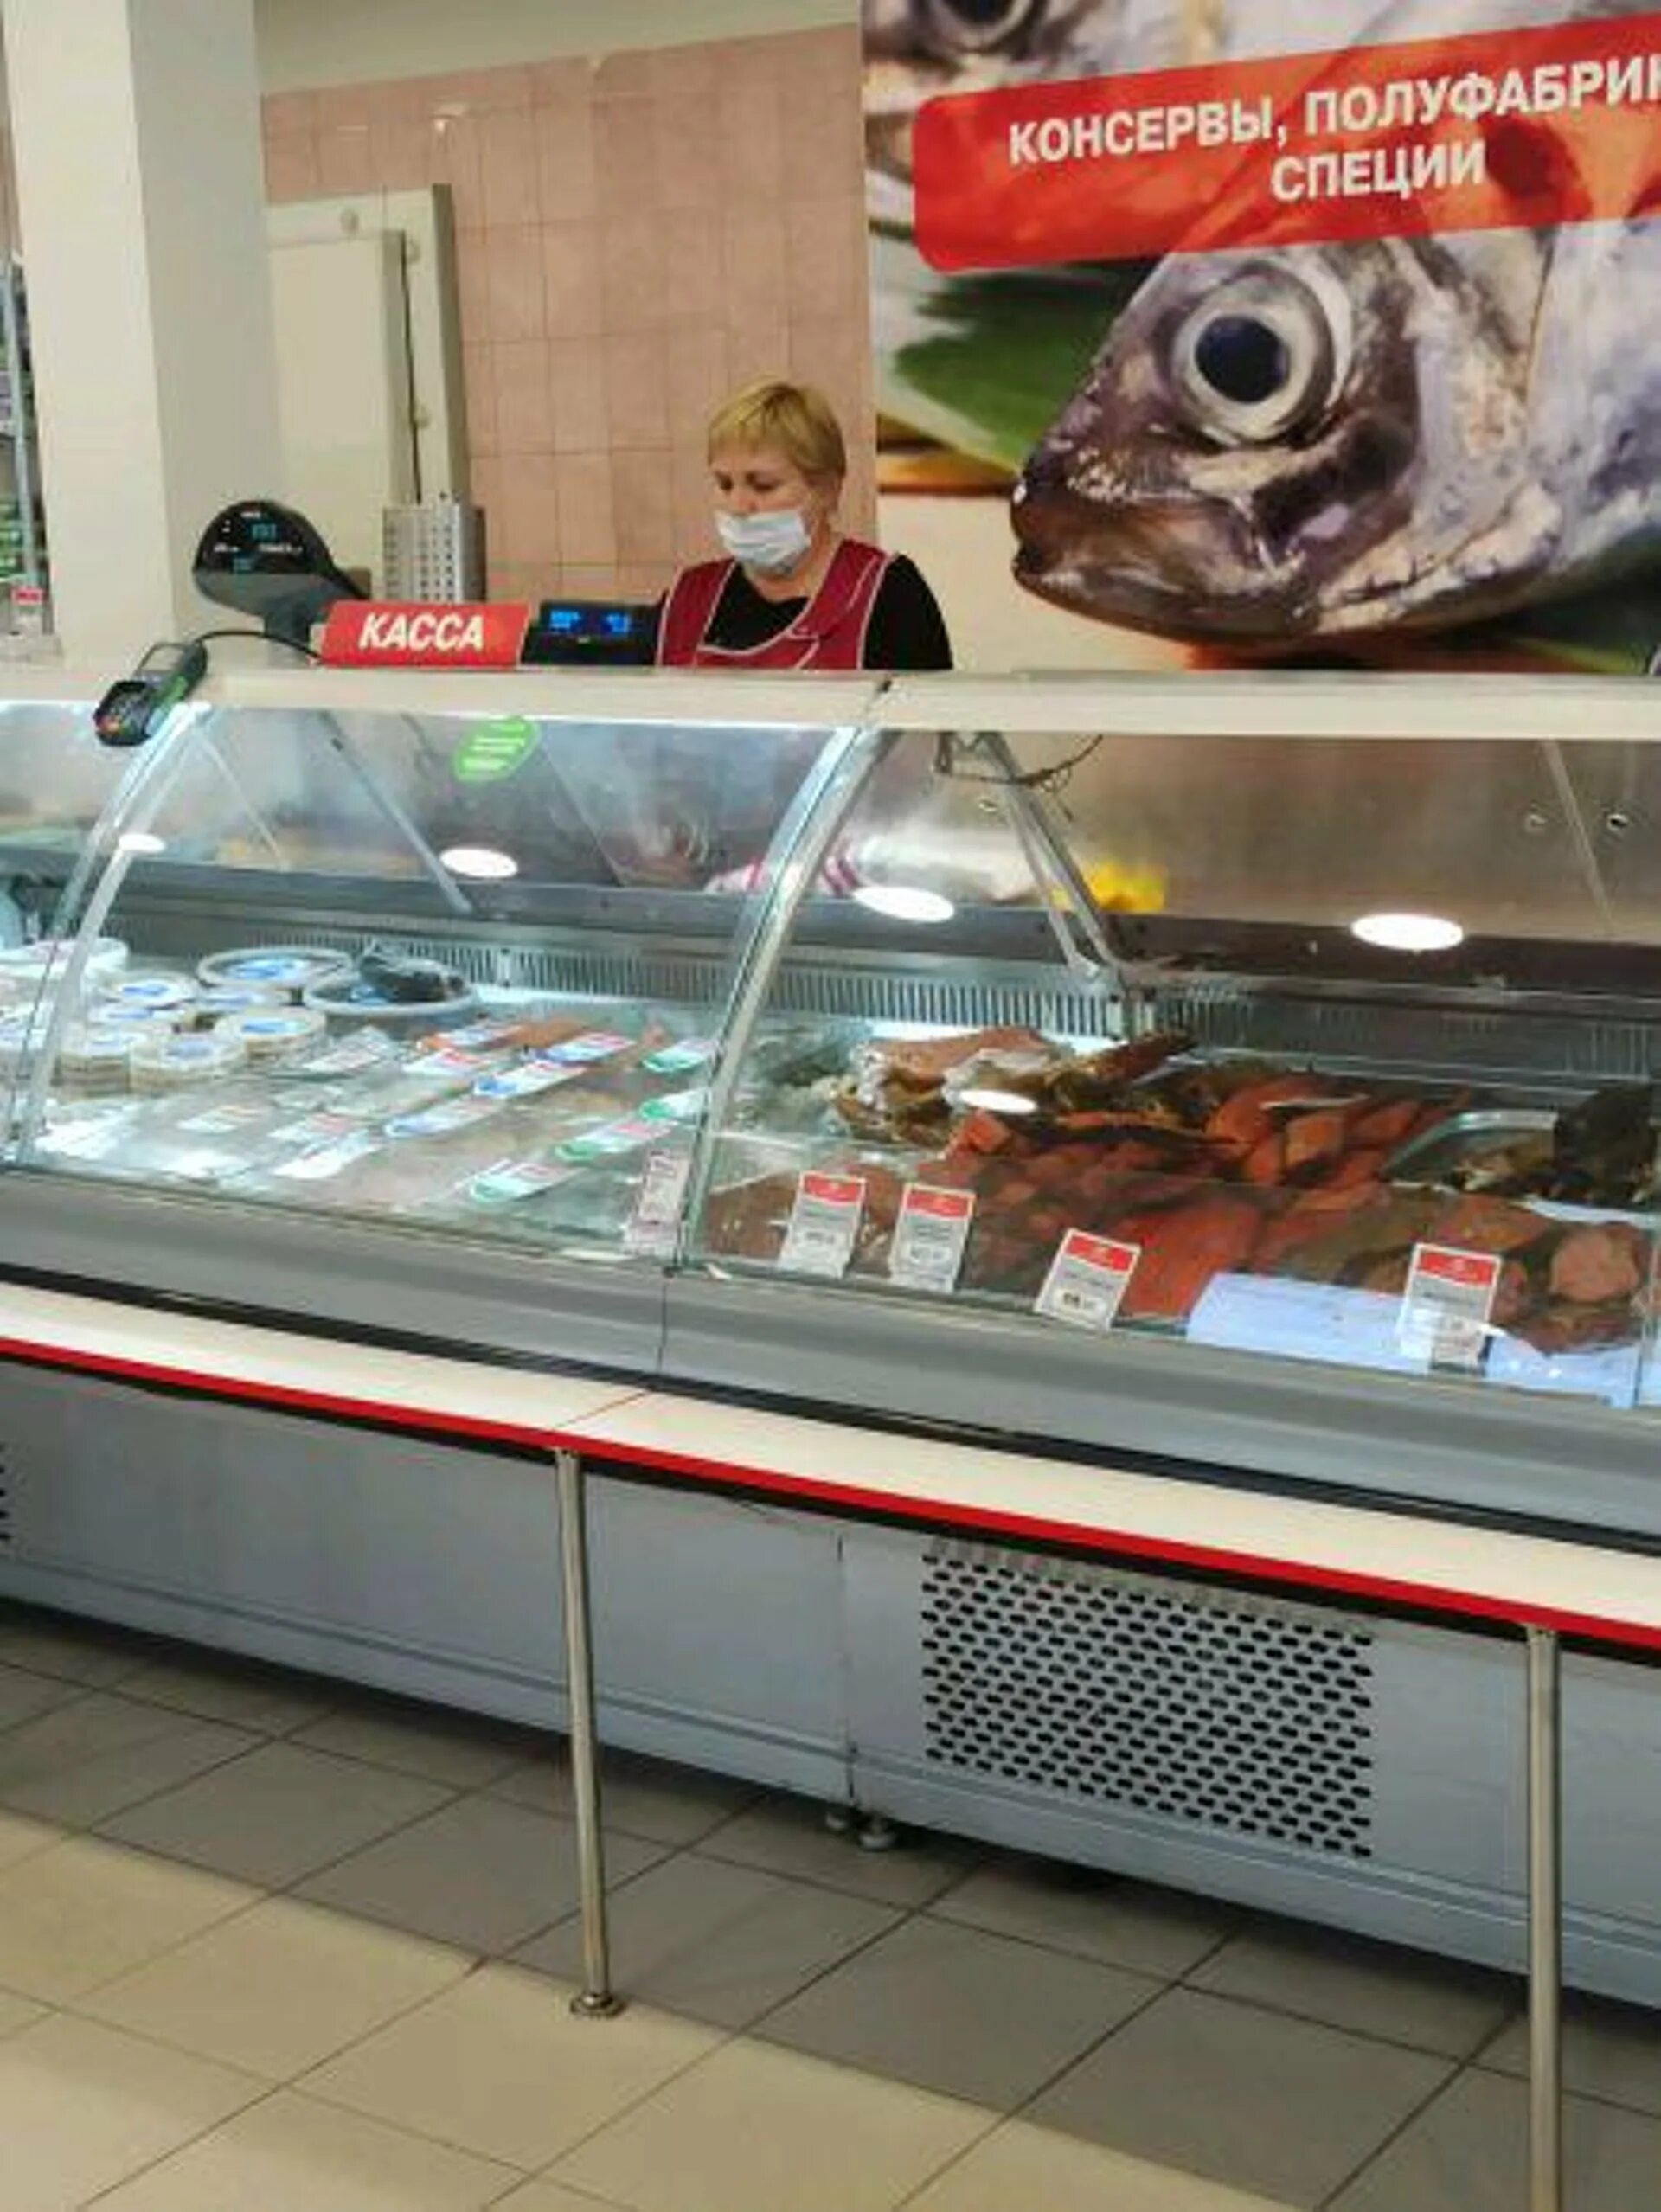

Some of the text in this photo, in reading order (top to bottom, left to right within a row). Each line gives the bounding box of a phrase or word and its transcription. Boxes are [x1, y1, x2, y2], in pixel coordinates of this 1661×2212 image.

[1009, 96, 1287, 166] КОНСЕРВЫ,
[1272, 140, 1486, 202] СПЕЦИИ
[358, 612, 484, 651] КАССА
